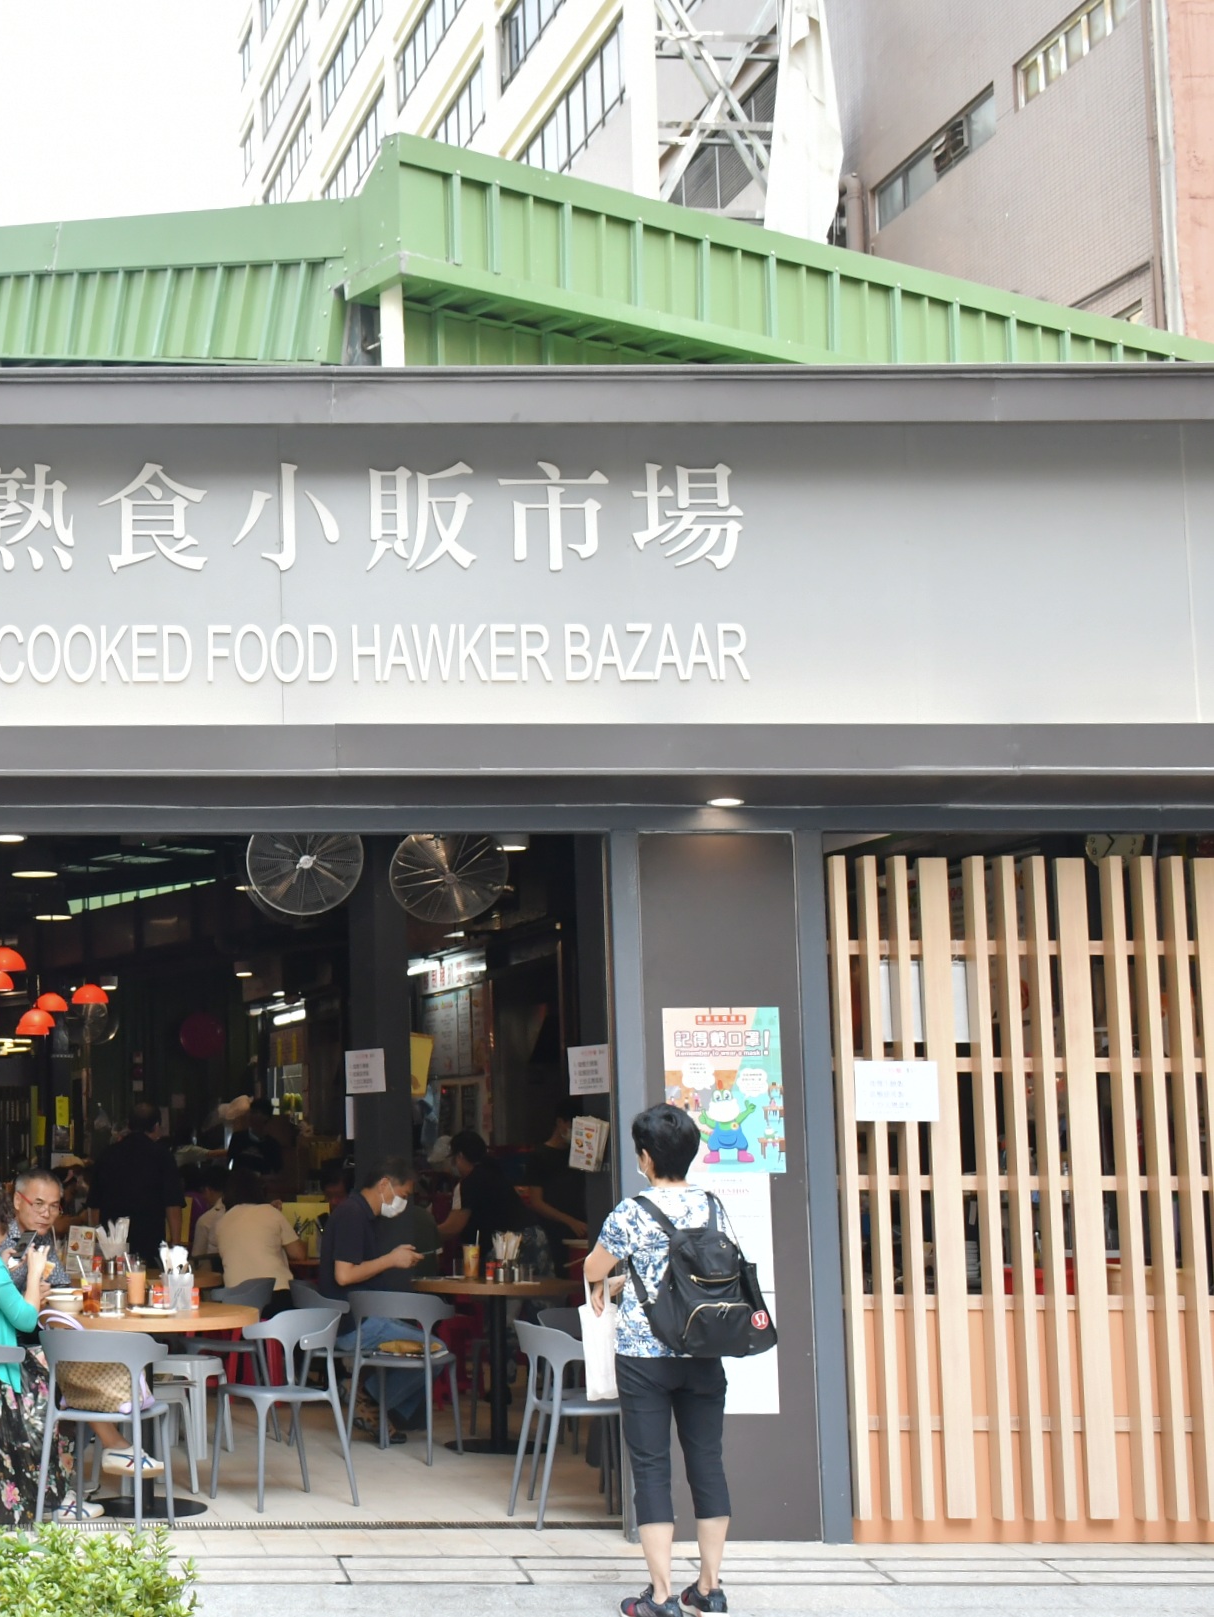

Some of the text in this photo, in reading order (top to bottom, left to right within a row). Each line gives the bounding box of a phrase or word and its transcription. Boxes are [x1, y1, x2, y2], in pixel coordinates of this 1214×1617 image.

[207, 623, 338, 684] FOOD
[351, 622, 553, 683] HAWKER
[564, 622, 751, 682] BAZAAR
